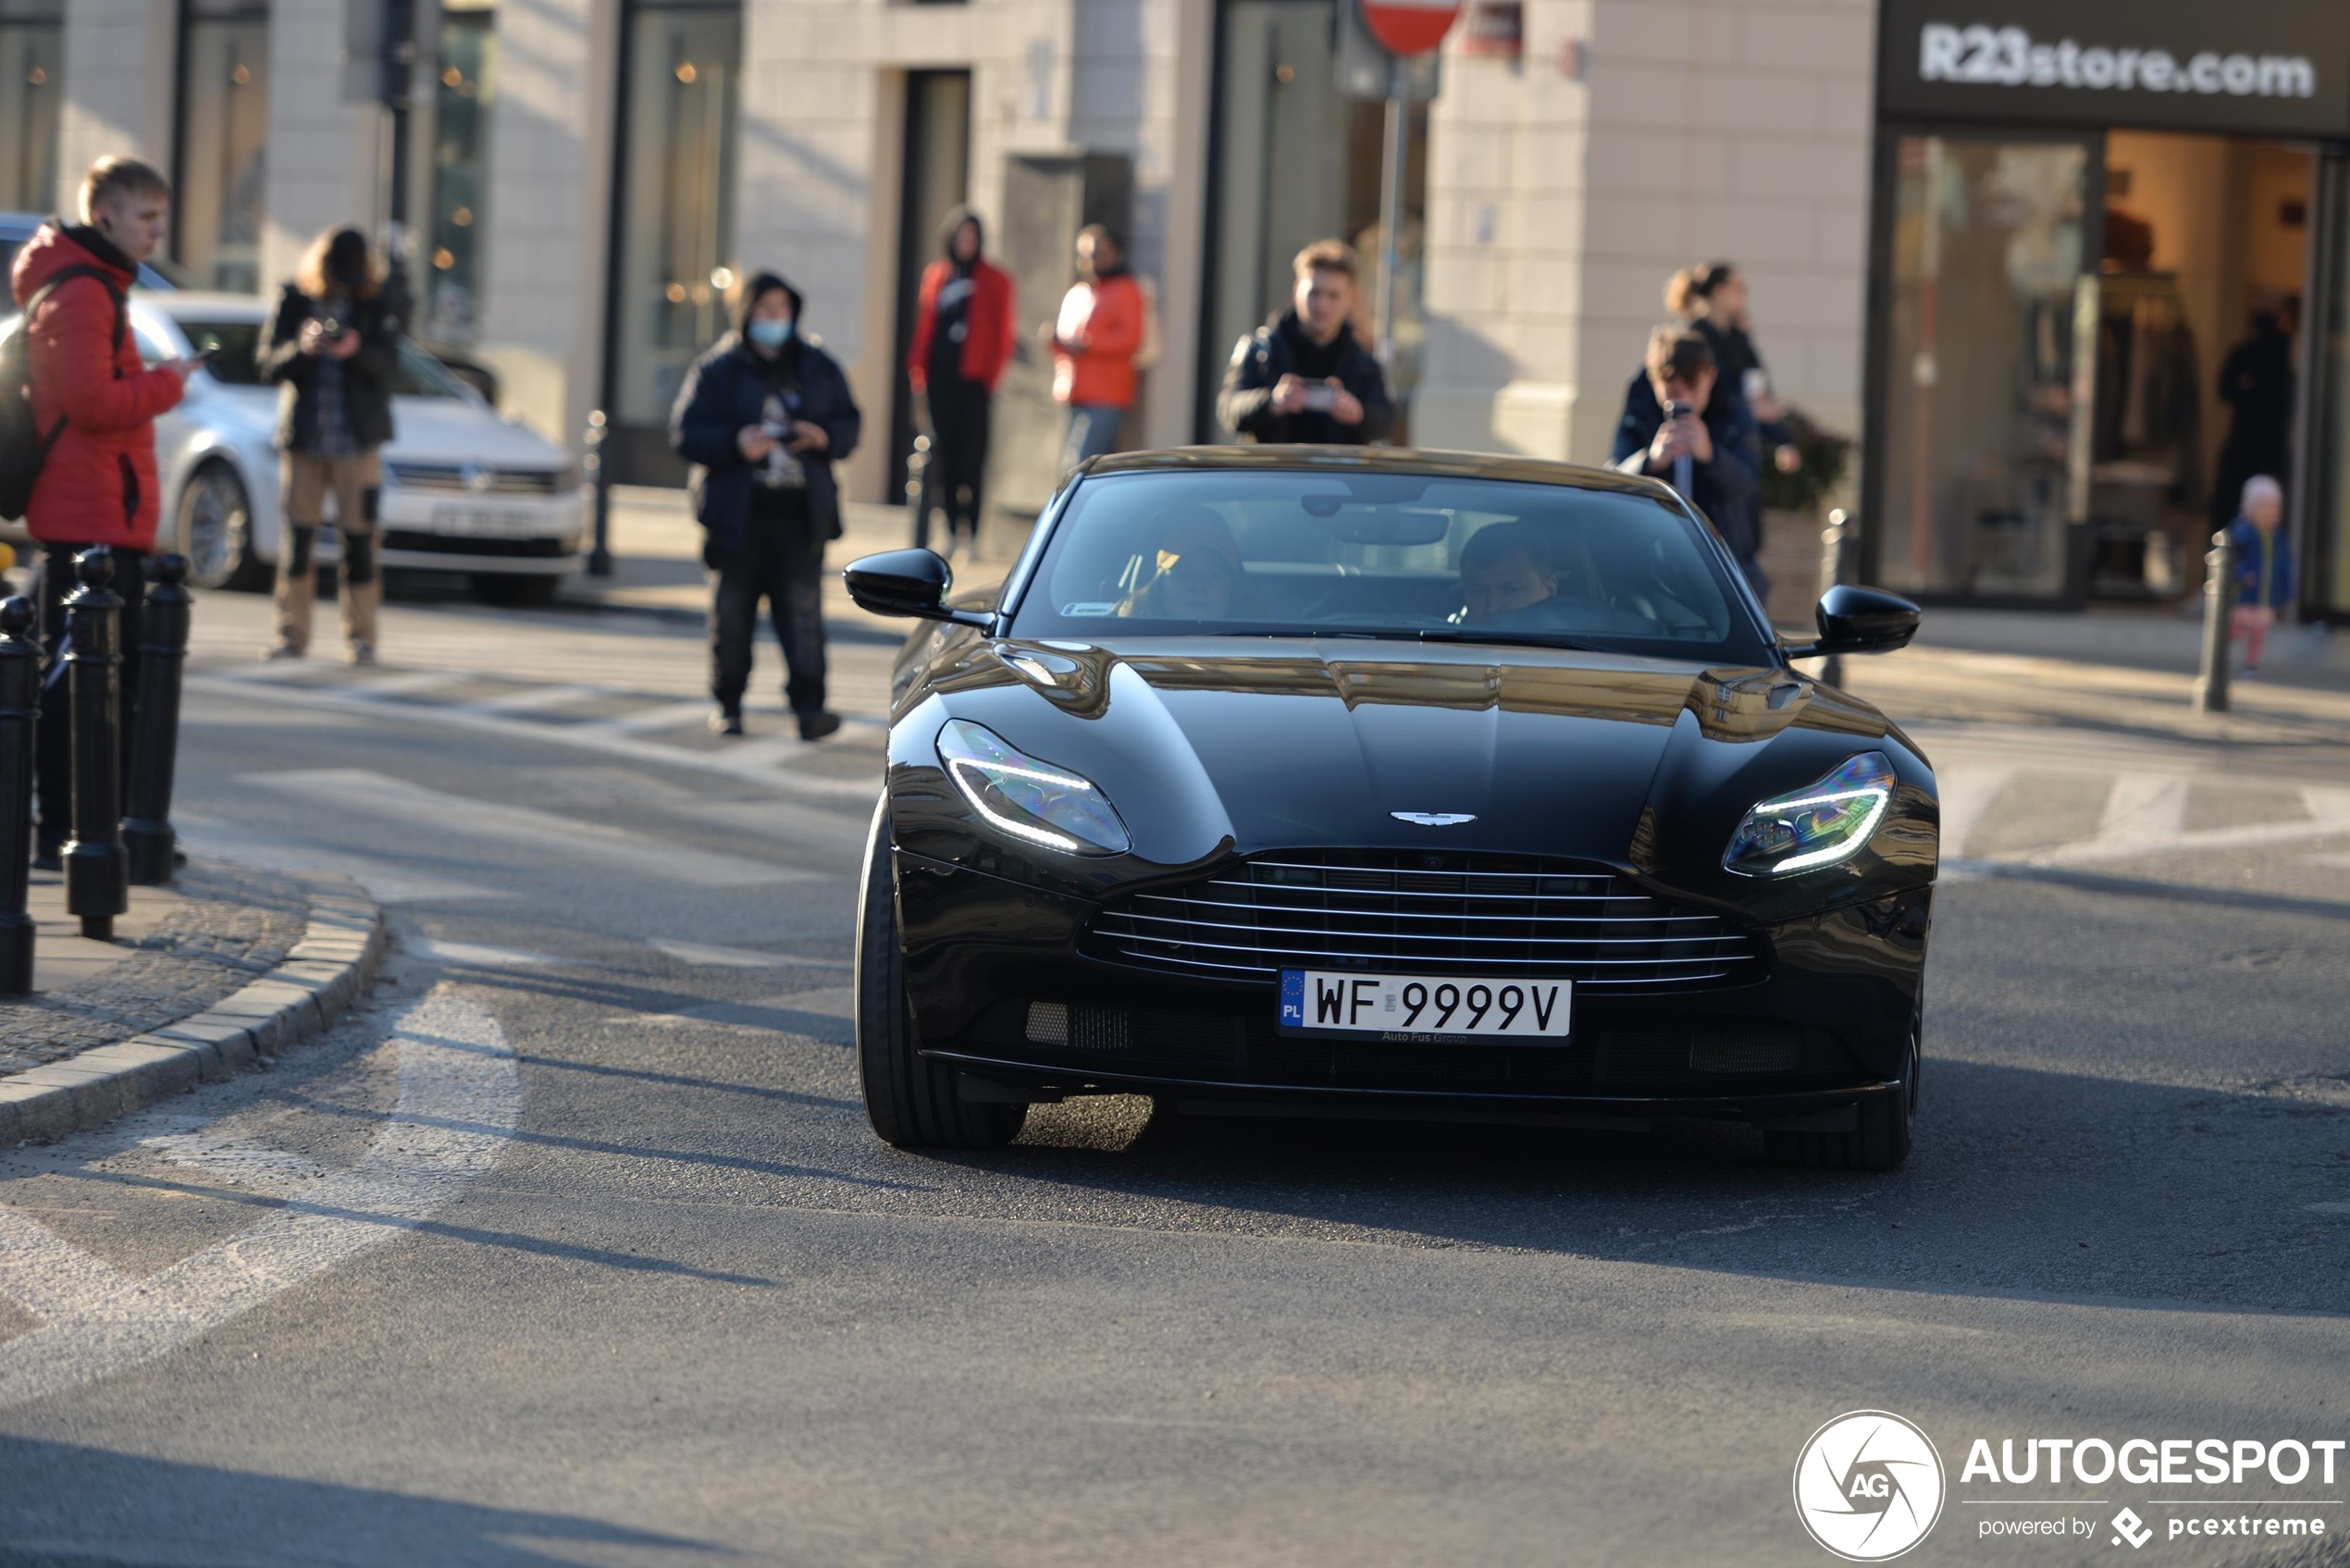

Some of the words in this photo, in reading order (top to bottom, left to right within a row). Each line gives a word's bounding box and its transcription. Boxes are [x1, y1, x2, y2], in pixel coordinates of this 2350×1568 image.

[1920, 23, 2315, 97] R23store.com
[1283, 1005, 1301, 1019] PL
[1317, 978, 1380, 1025] WF
[1402, 982, 1559, 1031] 9999V
[1382, 1031, 1408, 1042] Auto
[1411, 1032, 1430, 1043] Fus
[1433, 1032, 1467, 1044] Group
